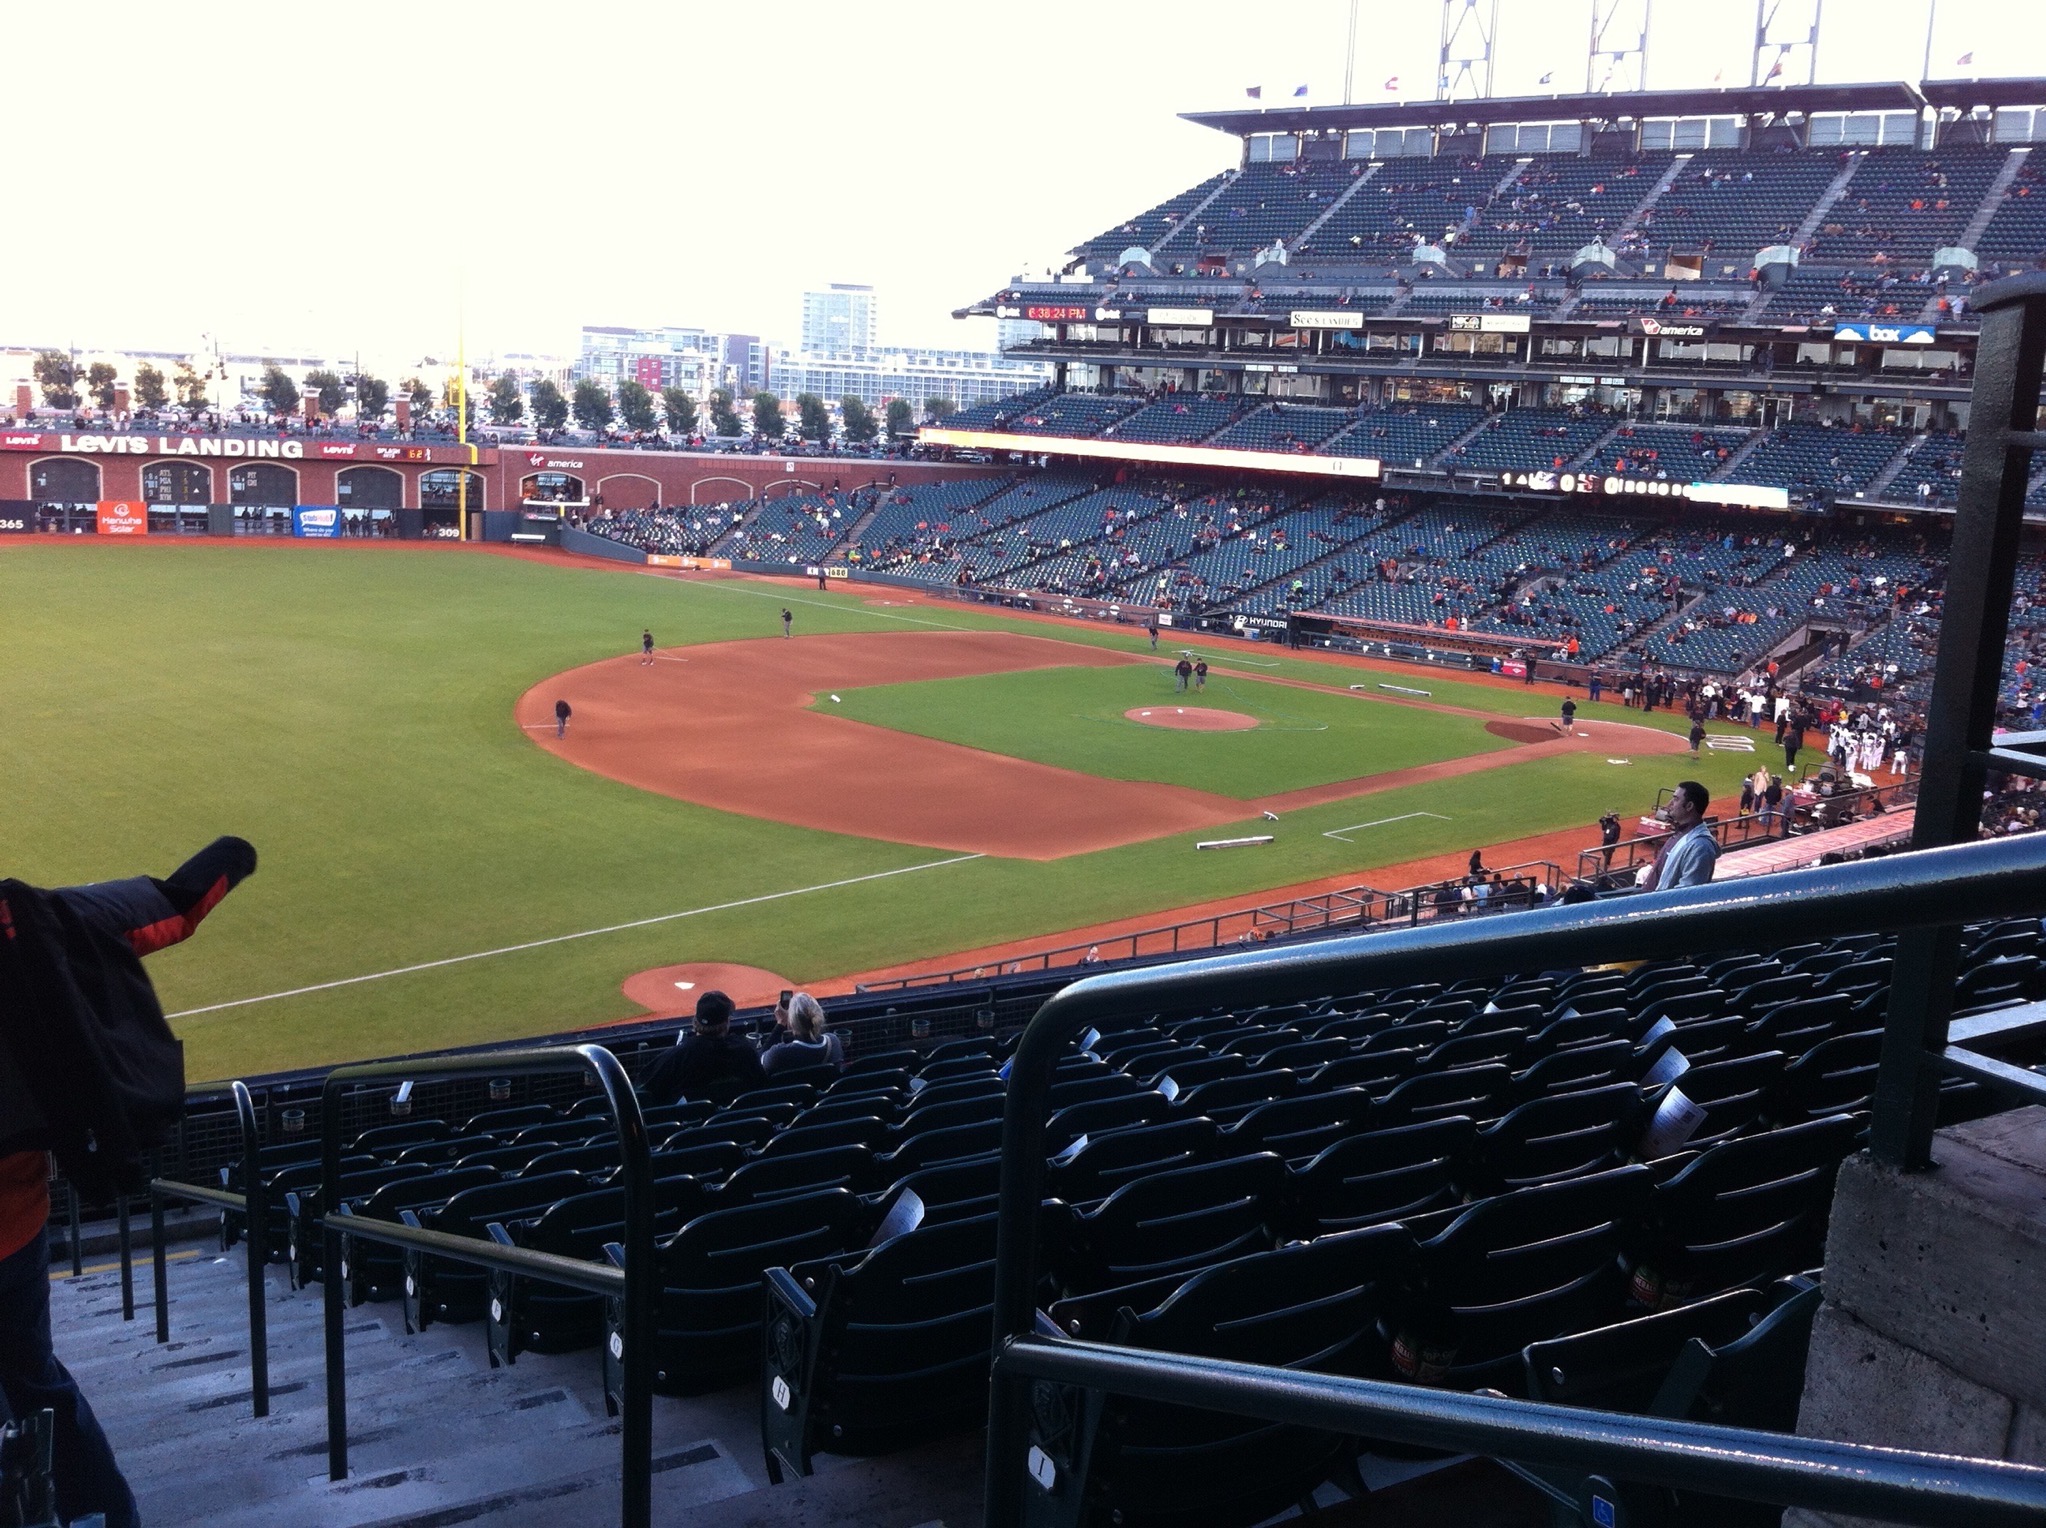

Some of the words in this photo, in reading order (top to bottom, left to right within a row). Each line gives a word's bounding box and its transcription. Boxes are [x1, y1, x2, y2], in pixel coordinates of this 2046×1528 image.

[1660, 325, 1703, 336] america
[1869, 324, 1900, 341] box
[159, 437, 303, 458] LANDING
[547, 460, 584, 469] america
[0, 520, 24, 529] 365
[102, 517, 142, 525] Hanwha
[438, 528, 460, 537] 309
[831, 569, 846, 577] 680
[1249, 616, 1288, 629] HYUNDAI
[613, 1337, 620, 1353] G
[777, 1382, 786, 1403] H
[1037, 1457, 1045, 1477] I
